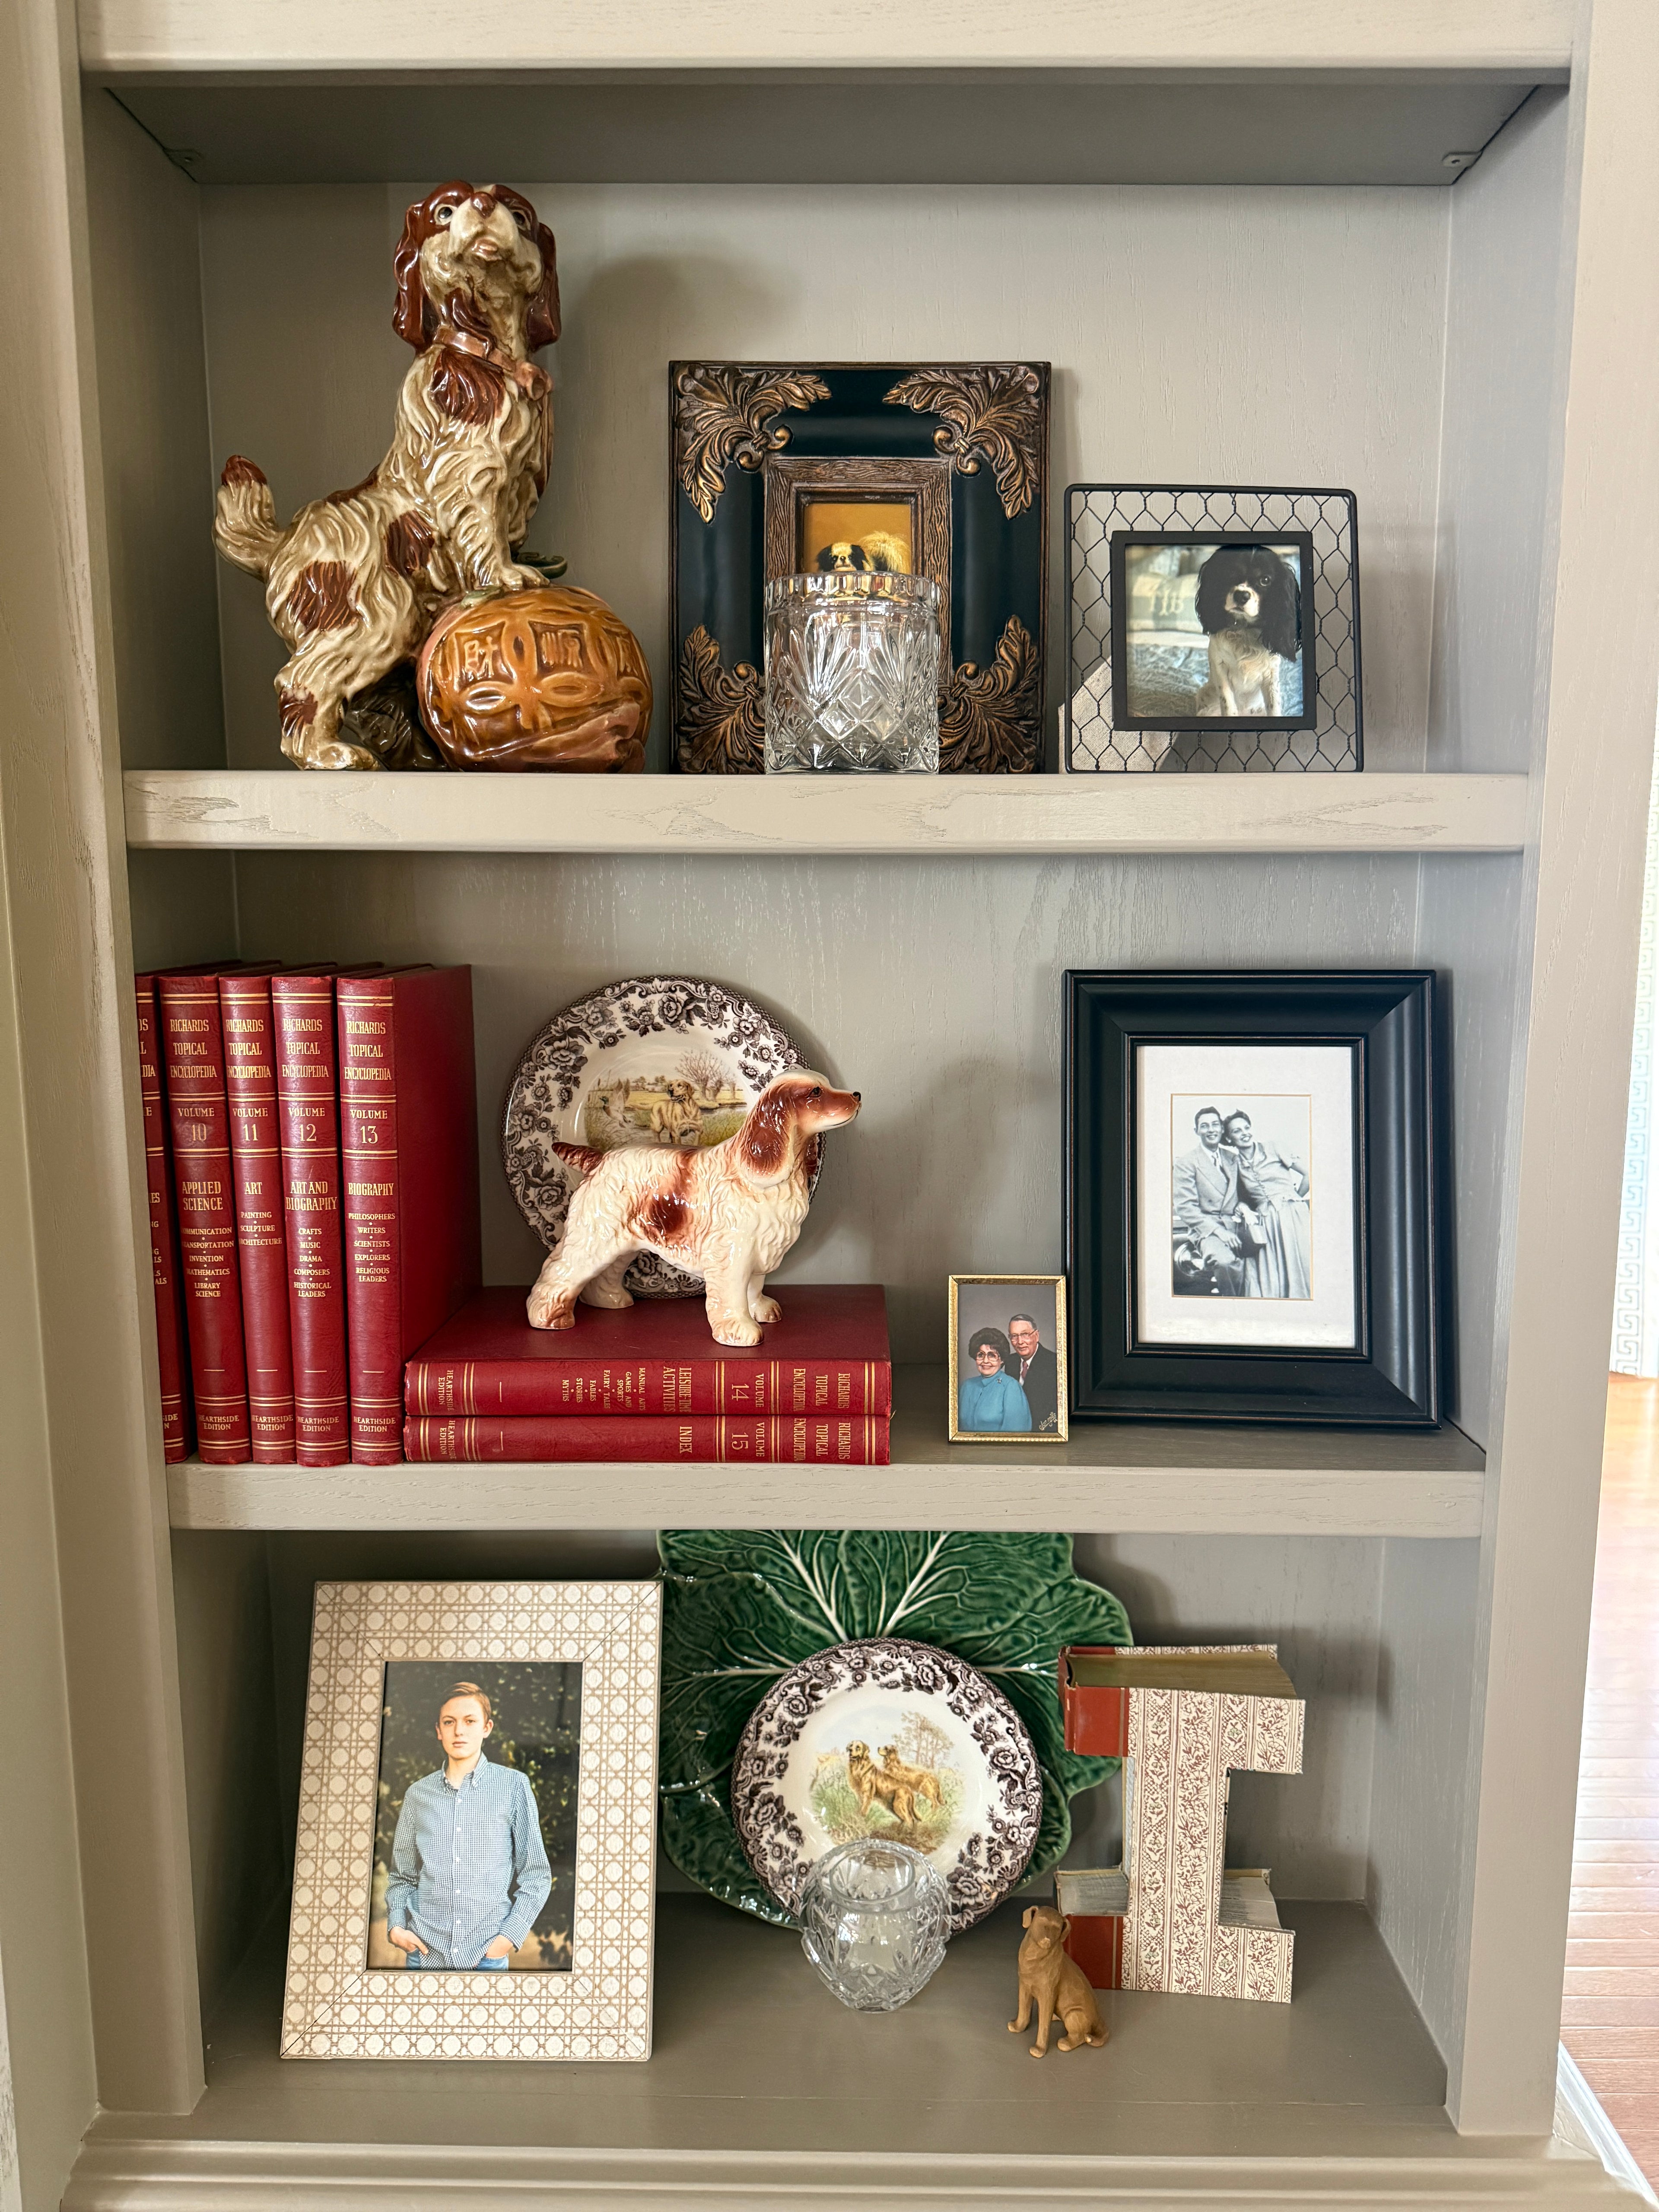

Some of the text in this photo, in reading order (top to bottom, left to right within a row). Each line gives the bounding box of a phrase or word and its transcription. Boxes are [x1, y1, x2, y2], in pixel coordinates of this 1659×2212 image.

[170, 1019, 209, 1032] RICHARDS
[226, 1019, 264, 1032] RICHARDS
[283, 1018, 322, 1032] RICHARDS
[346, 1020, 385, 1034] RICHARDS
[173, 1042, 207, 1055] TOPICAL
[229, 1042, 262, 1055] TOPICAL
[286, 1042, 320, 1055] TOPICAL
[349, 1044, 383, 1058] TOPICAL
[170, 1066, 217, 1078] ENCYCLOPEDIA
[227, 1065, 272, 1078] ENCYCLOPEDIA
[282, 1065, 329, 1077] ENCYCLOPEDIA
[344, 1067, 392, 1081] ENCYCLOPEDIA
[178, 1108, 214, 1117] VOLUME
[233, 1108, 268, 1117] VOLUME
[289, 1107, 325, 1116] VOLUME
[350, 1109, 388, 1119] VOLUME
[191, 1124, 207, 1141] 10
[243, 1124, 258, 1141] 11
[299, 1124, 316, 1141] 12
[360, 1125, 378, 1144] 13
[182, 1182, 221, 1194] APPLIED
[245, 1182, 263, 1195] ART
[290, 1181, 328, 1194] ART AND
[348, 1183, 394, 1196] BIOGRAPHY
[183, 1198, 223, 1211] SCIENCE
[286, 1197, 338, 1211] BIOGRAPHY
[182, 1241, 234, 1249] RANSPORTATION
[446, 1370, 454, 1411] HEARTHSIDE
[663, 1366, 675, 1412] ACTIVITIES
[679, 1367, 691, 1412] LEISURE-TIME
[731, 1383, 749, 1401] 14
[755, 1373, 764, 1407] VOLUME
[793, 1369, 805, 1411] ENCYCLOPEDIA
[816, 1375, 828, 1406] TOPICAL
[838, 1373, 850, 1408] RICHARDS
[297, 1416, 339, 1424] HEARTHSIDE
[354, 1416, 396, 1424] HEARTHSIDE
[448, 1421, 456, 1459] HEARTHSIDE
[679, 1426, 692, 1453] INDEX
[731, 1432, 748, 1450] 15
[756, 1422, 764, 1457] VOLUME
[793, 1418, 806, 1461] ENCYCLOPEDIA
[816, 1424, 828, 1456] TOPICAL
[838, 1422, 850, 1459] RICHARDS
